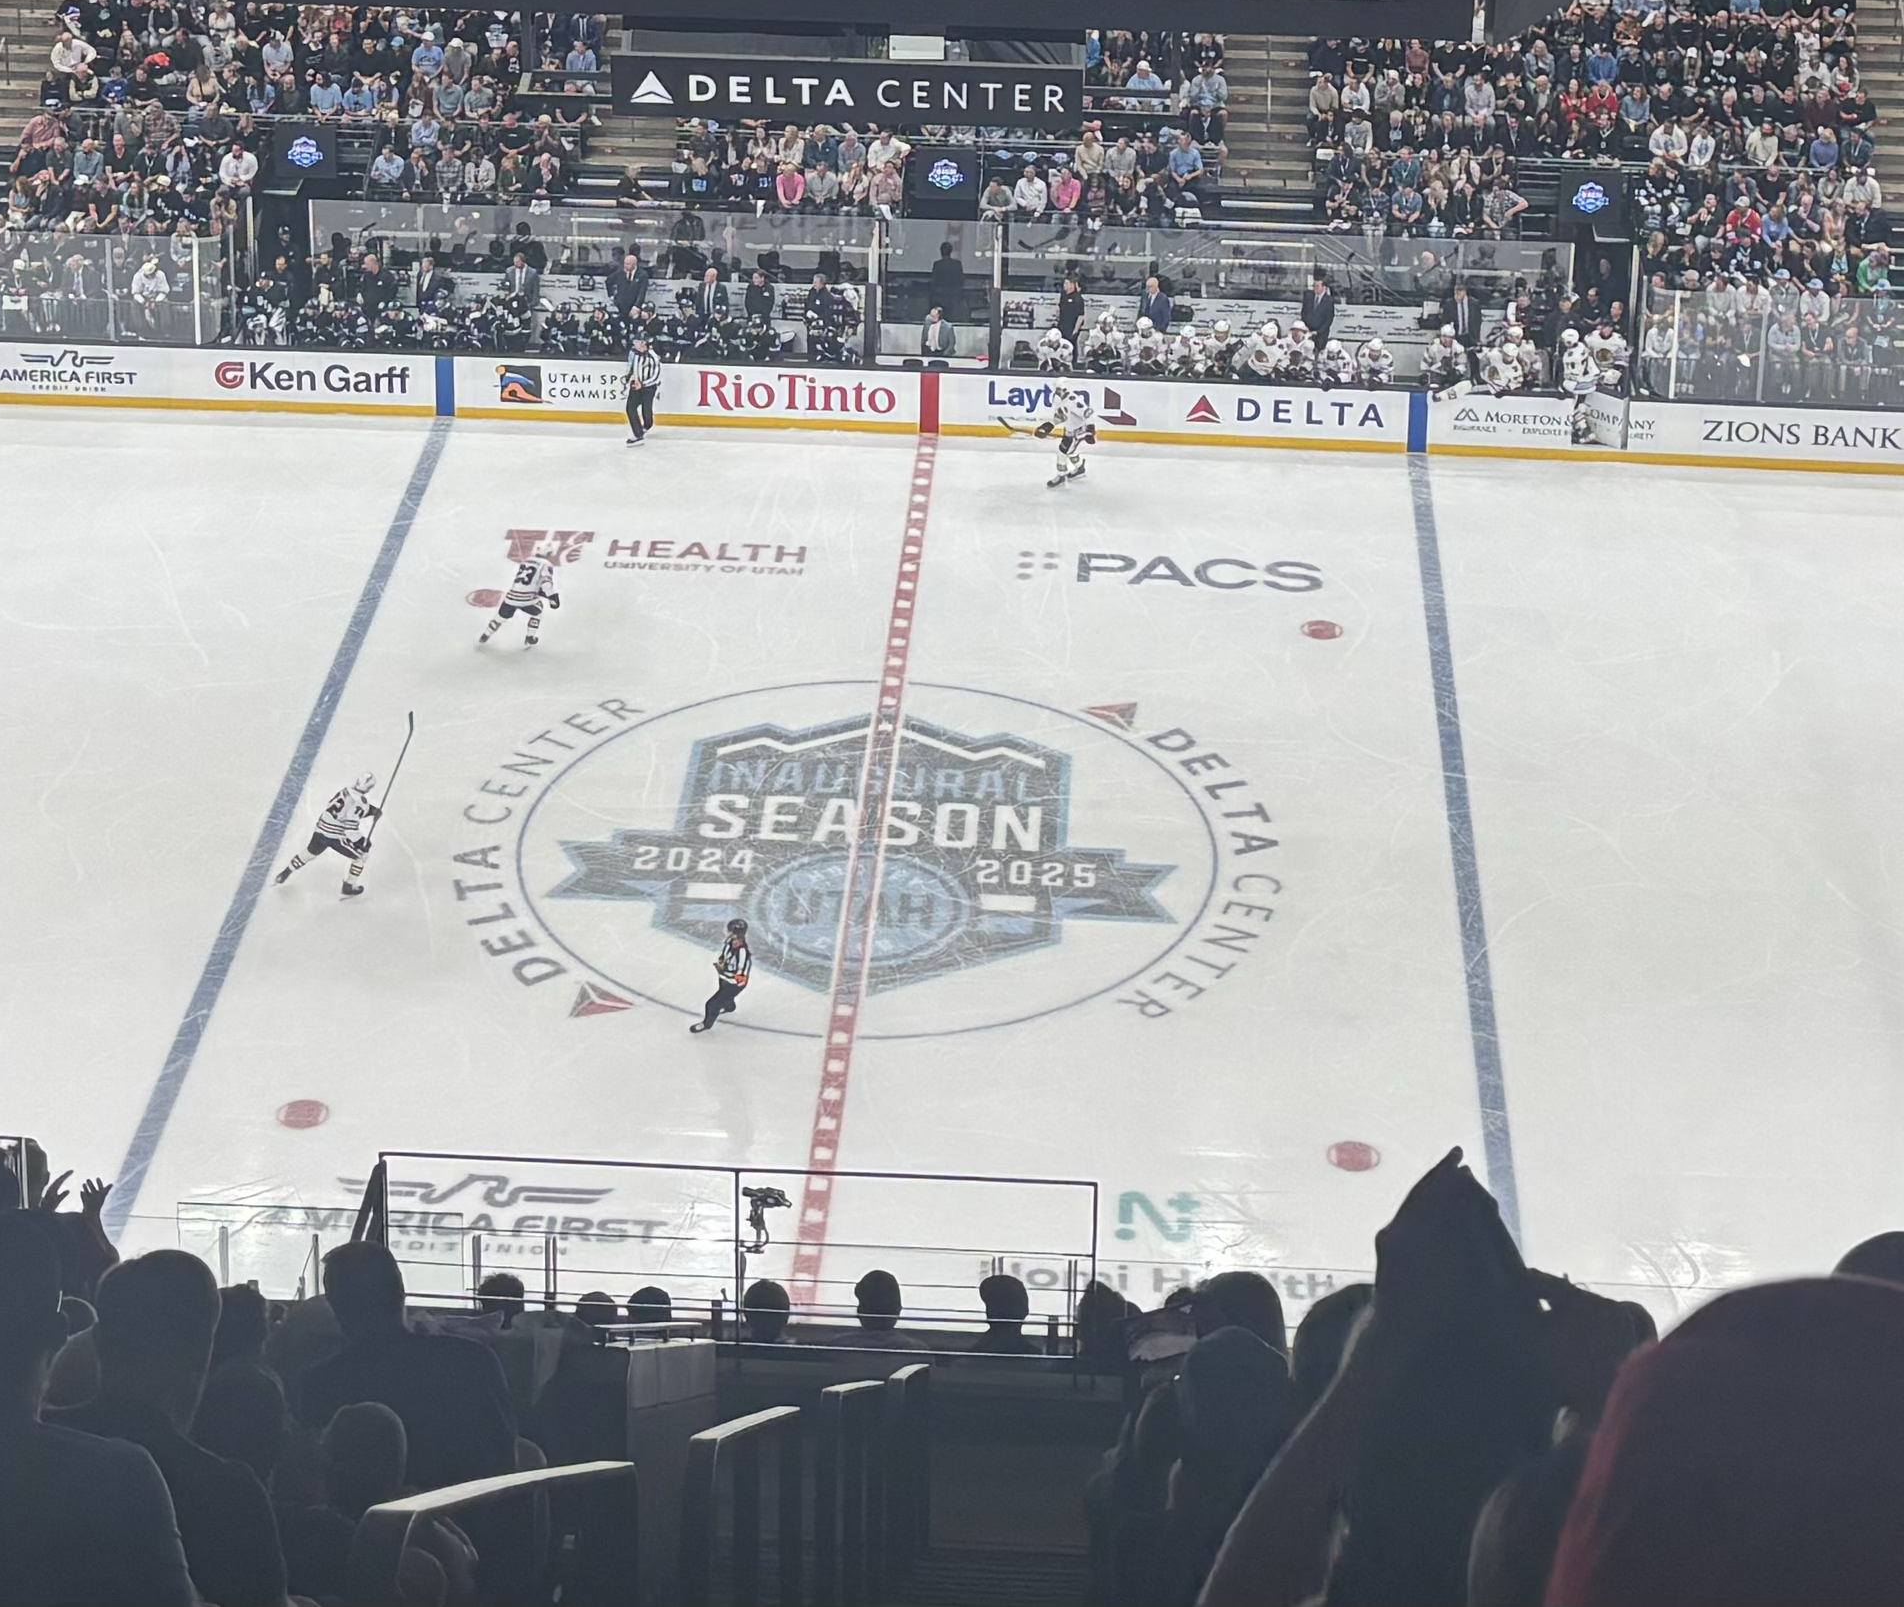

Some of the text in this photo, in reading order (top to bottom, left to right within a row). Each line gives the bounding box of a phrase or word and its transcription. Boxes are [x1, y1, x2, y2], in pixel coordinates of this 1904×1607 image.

[688, 74, 1065, 113] DELTA CENTER
[0, 367, 138, 386] AMERICA FIRST
[248, 361, 410, 395] Ken Garff
[1236, 397, 1385, 429] DELTA
[1703, 419, 1904, 450] ZIONS BANK
[606, 535, 808, 566] HEALTH
[514, 563, 538, 586] 23
[750, 565, 805, 577] UTAH
[1075, 551, 1325, 593] PACS
[698, 792, 1044, 853] SEASON
[454, 696, 646, 989] DELTA CENTER
[630, 843, 757, 874] 2024
[1116, 725, 1284, 1023] DELTA CENTER
[975, 860, 1098, 889] 2025
